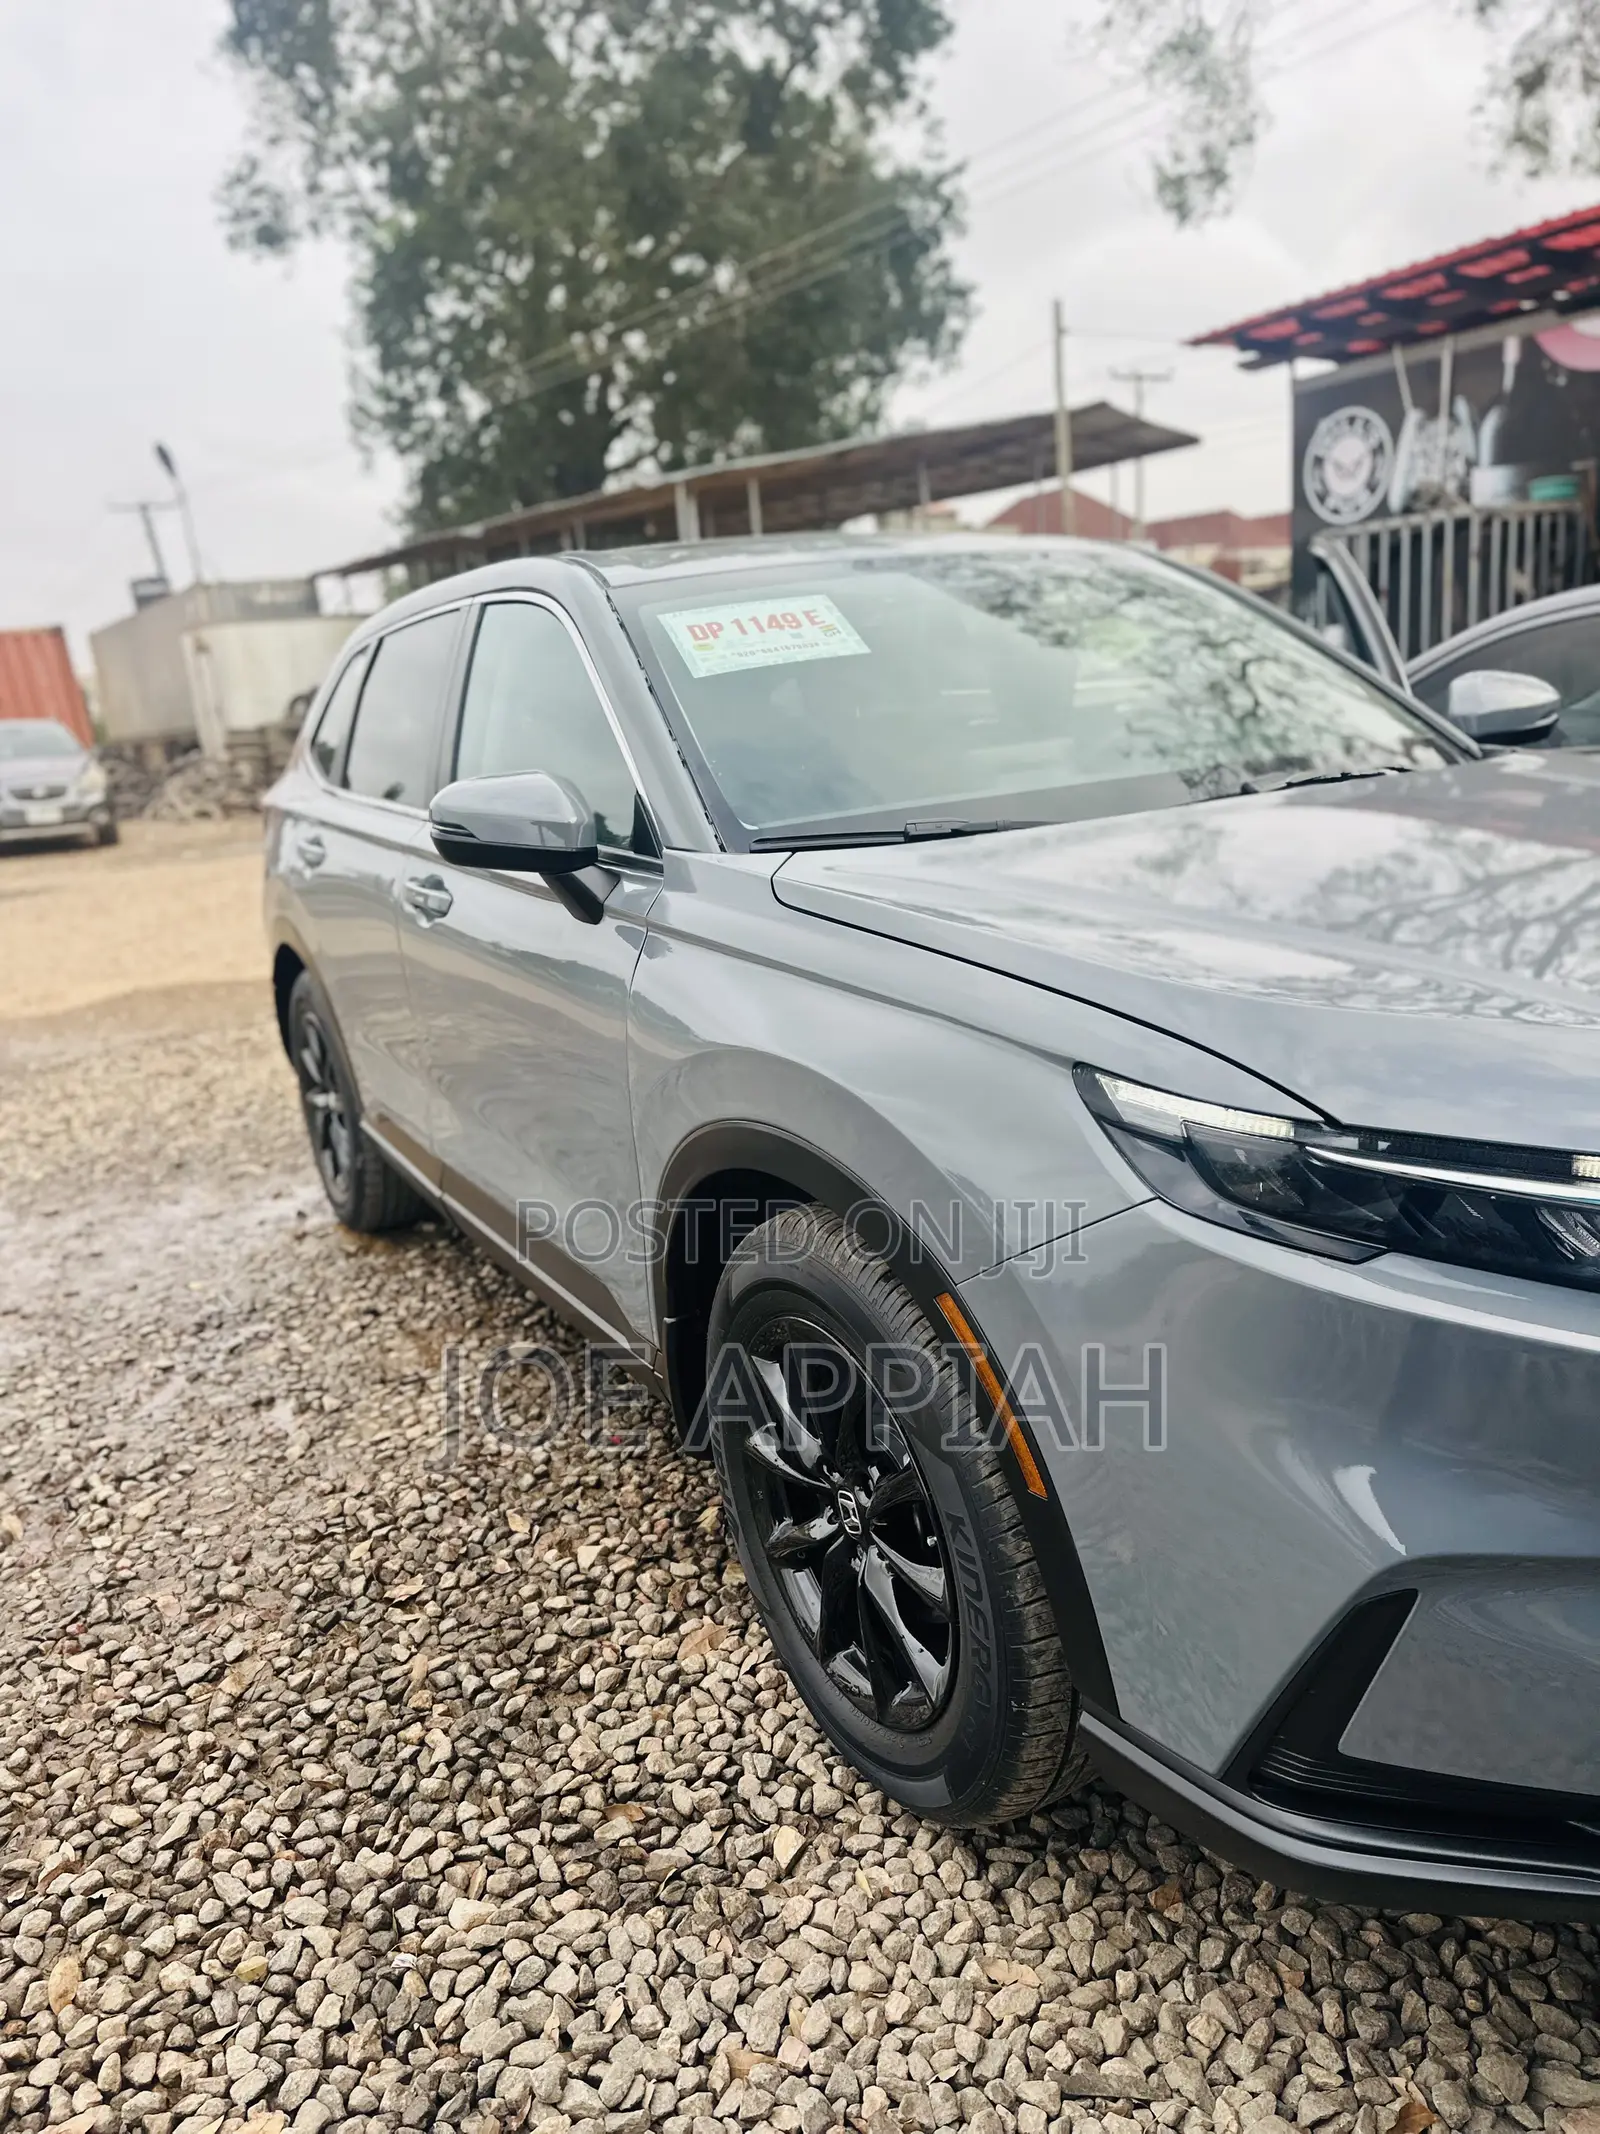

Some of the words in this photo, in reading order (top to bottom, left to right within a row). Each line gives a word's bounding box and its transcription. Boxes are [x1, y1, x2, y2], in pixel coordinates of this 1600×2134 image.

[686, 621, 724, 641] DP
[731, 611, 803, 635] 1149
[802, 609, 826, 626] E
